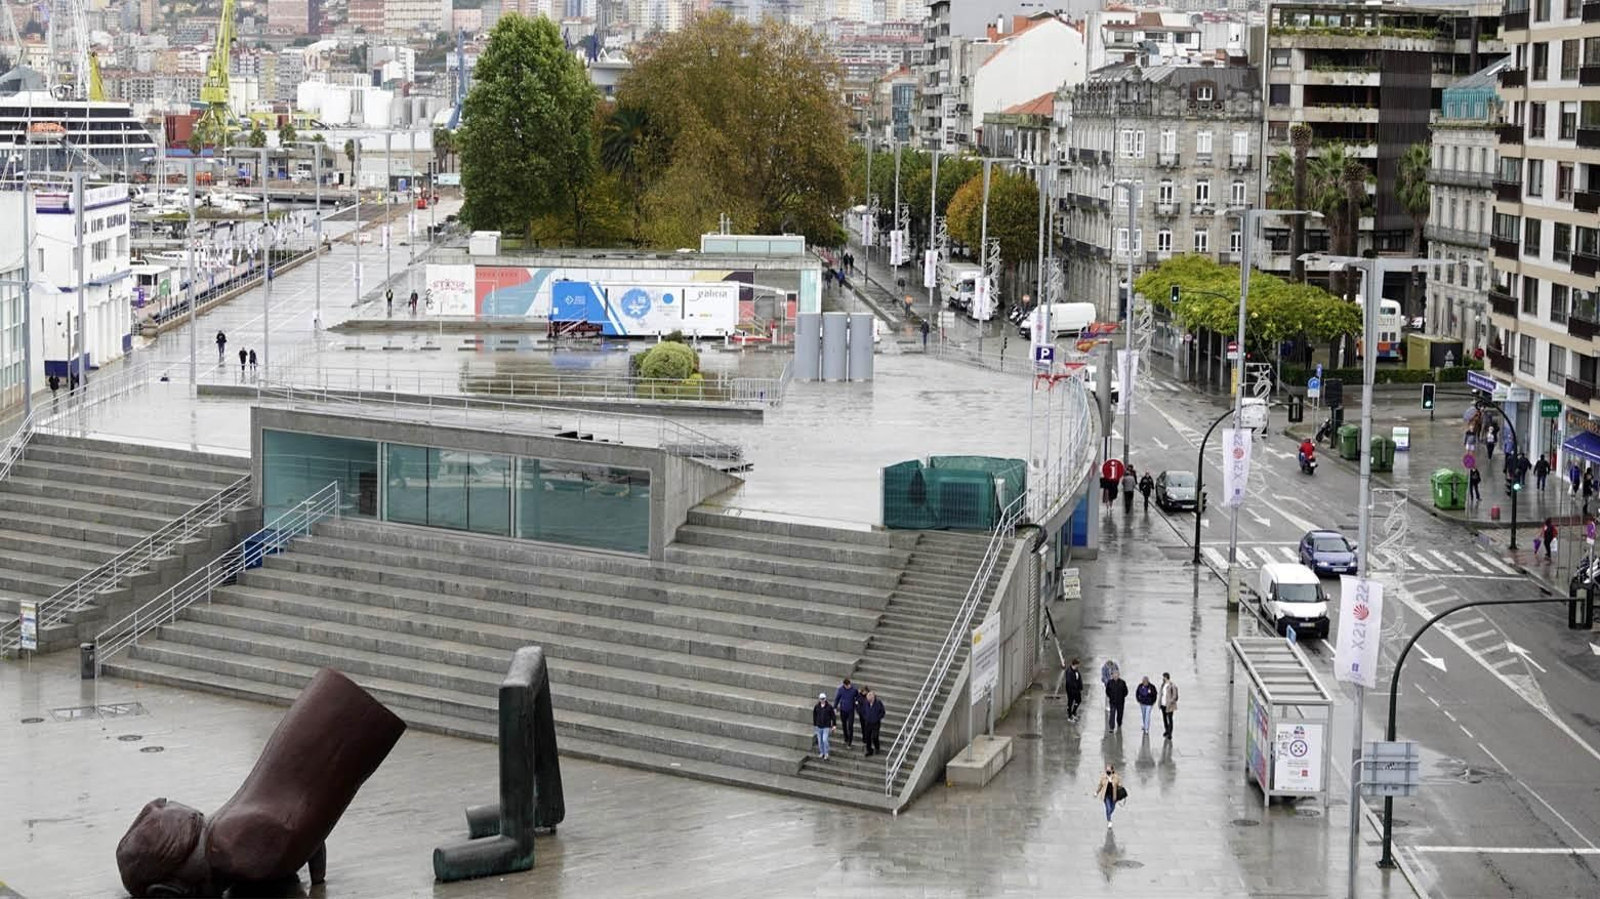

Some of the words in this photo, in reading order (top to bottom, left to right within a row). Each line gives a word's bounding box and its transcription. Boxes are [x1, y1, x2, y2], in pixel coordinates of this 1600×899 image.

[1041, 347, 1050, 359] P
[1355, 583, 1370, 604] 22
[1351, 622, 1367, 650] X21
